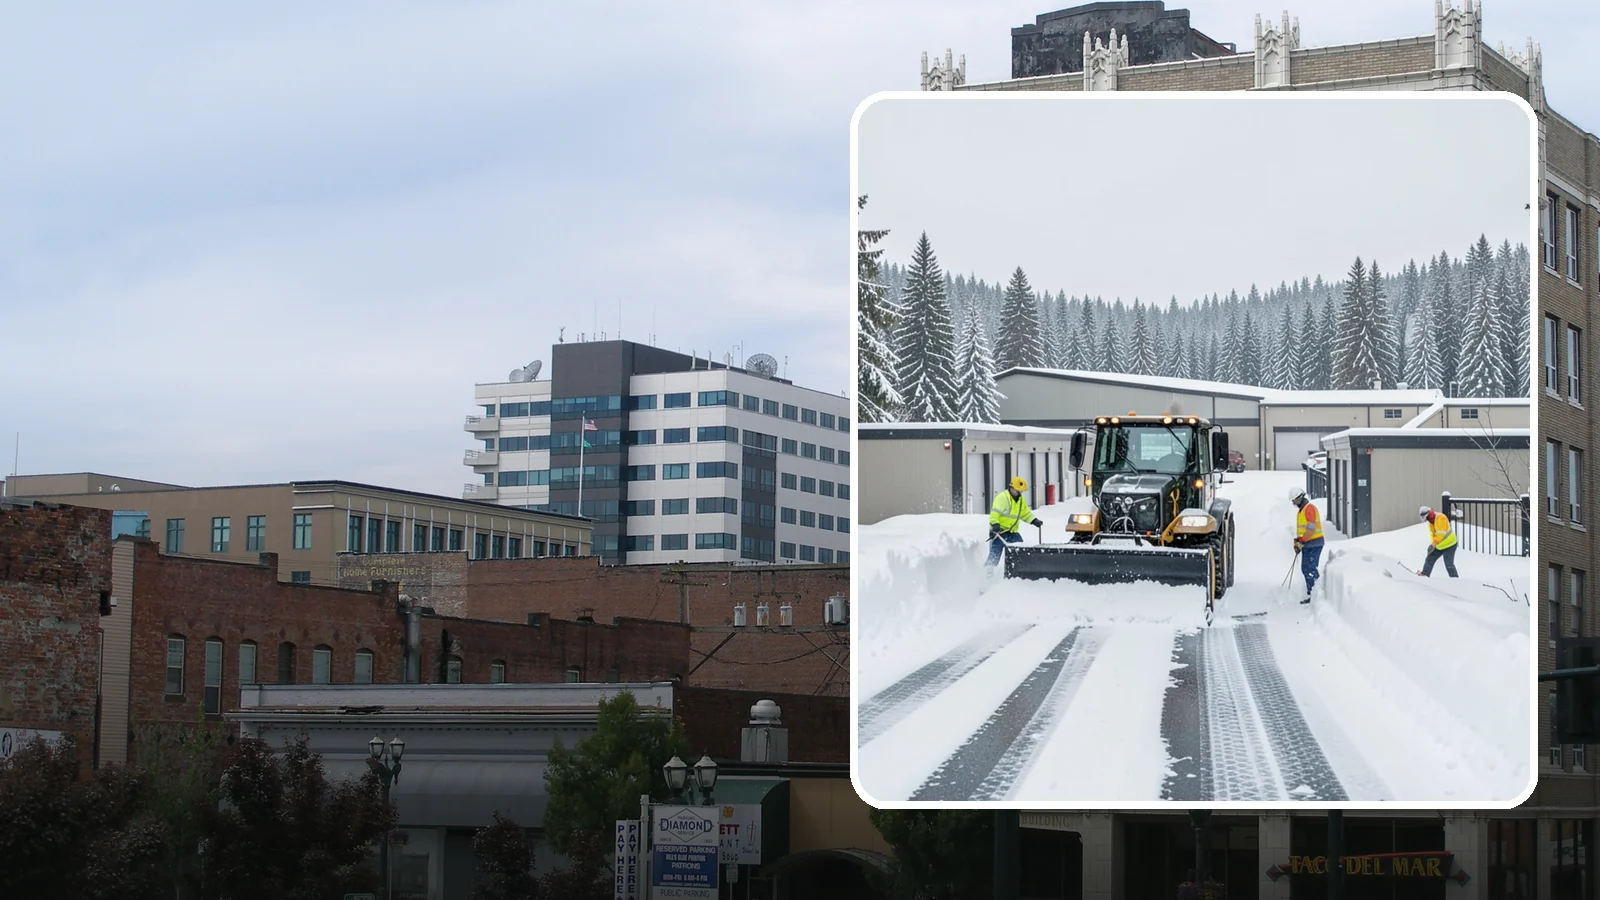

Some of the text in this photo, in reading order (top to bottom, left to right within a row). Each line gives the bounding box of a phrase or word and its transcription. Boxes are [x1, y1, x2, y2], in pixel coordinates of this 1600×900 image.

[660, 818, 713, 833] DIAMOND
[1021, 815, 1071, 828] BUILDING
[656, 845, 716, 854] RESERVED PARKING
[616, 825, 625, 894] PAY HERE
[628, 824, 637, 893] PAY HERE
[671, 861, 701, 870] PATRONS
[1288, 855, 1442, 877] TAC DEL MAR
[660, 888, 710, 898] PUBLIC PARKING
